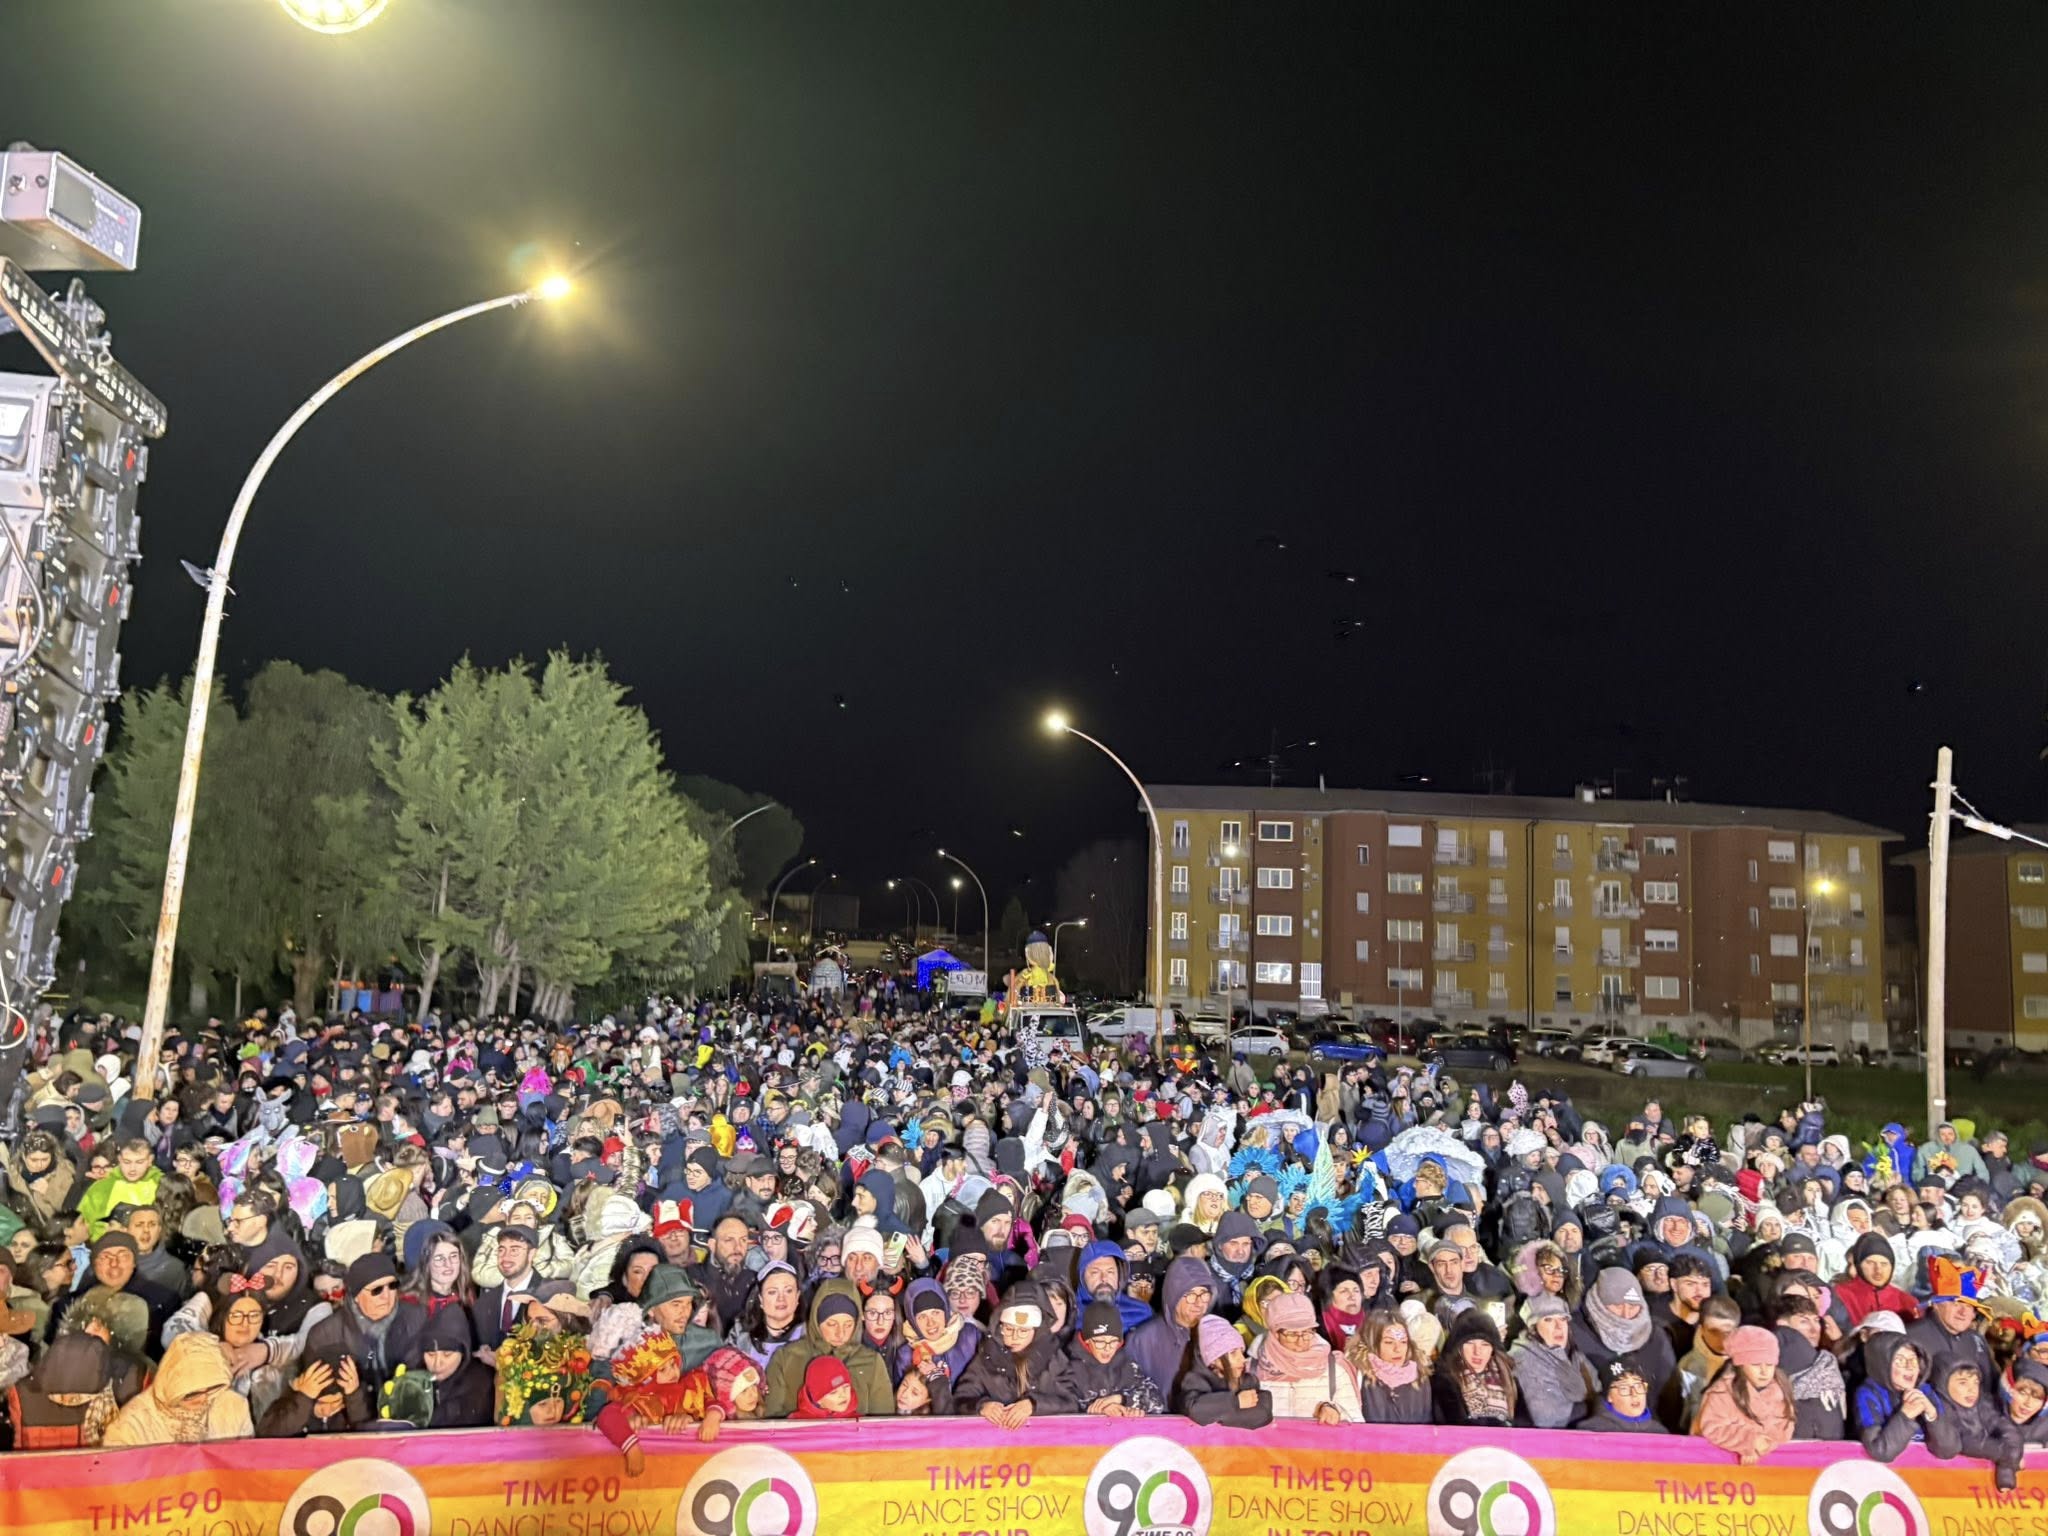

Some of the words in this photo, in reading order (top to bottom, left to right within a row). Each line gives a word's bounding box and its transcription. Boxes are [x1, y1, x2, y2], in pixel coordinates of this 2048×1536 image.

[926, 1463, 1032, 1491] TIME90
[1269, 1465, 1373, 1493] TIME90
[503, 1476, 621, 1507] TIME90
[1655, 1480, 1757, 1506] TIME90
[1968, 1486, 2048, 1509] TIME9
[88, 1488, 222, 1531] TIME90
[451, 1513, 555, 1536] DANCE
[567, 1508, 663, 1536] SHOW
[883, 1497, 976, 1526] DANCE
[985, 1495, 1071, 1522] SHOW
[1228, 1494, 1319, 1522] DANCE
[1329, 1499, 1413, 1526] SHOW
[1618, 1510, 1706, 1536] DANCE
[1716, 1513, 1795, 1536] SHOW
